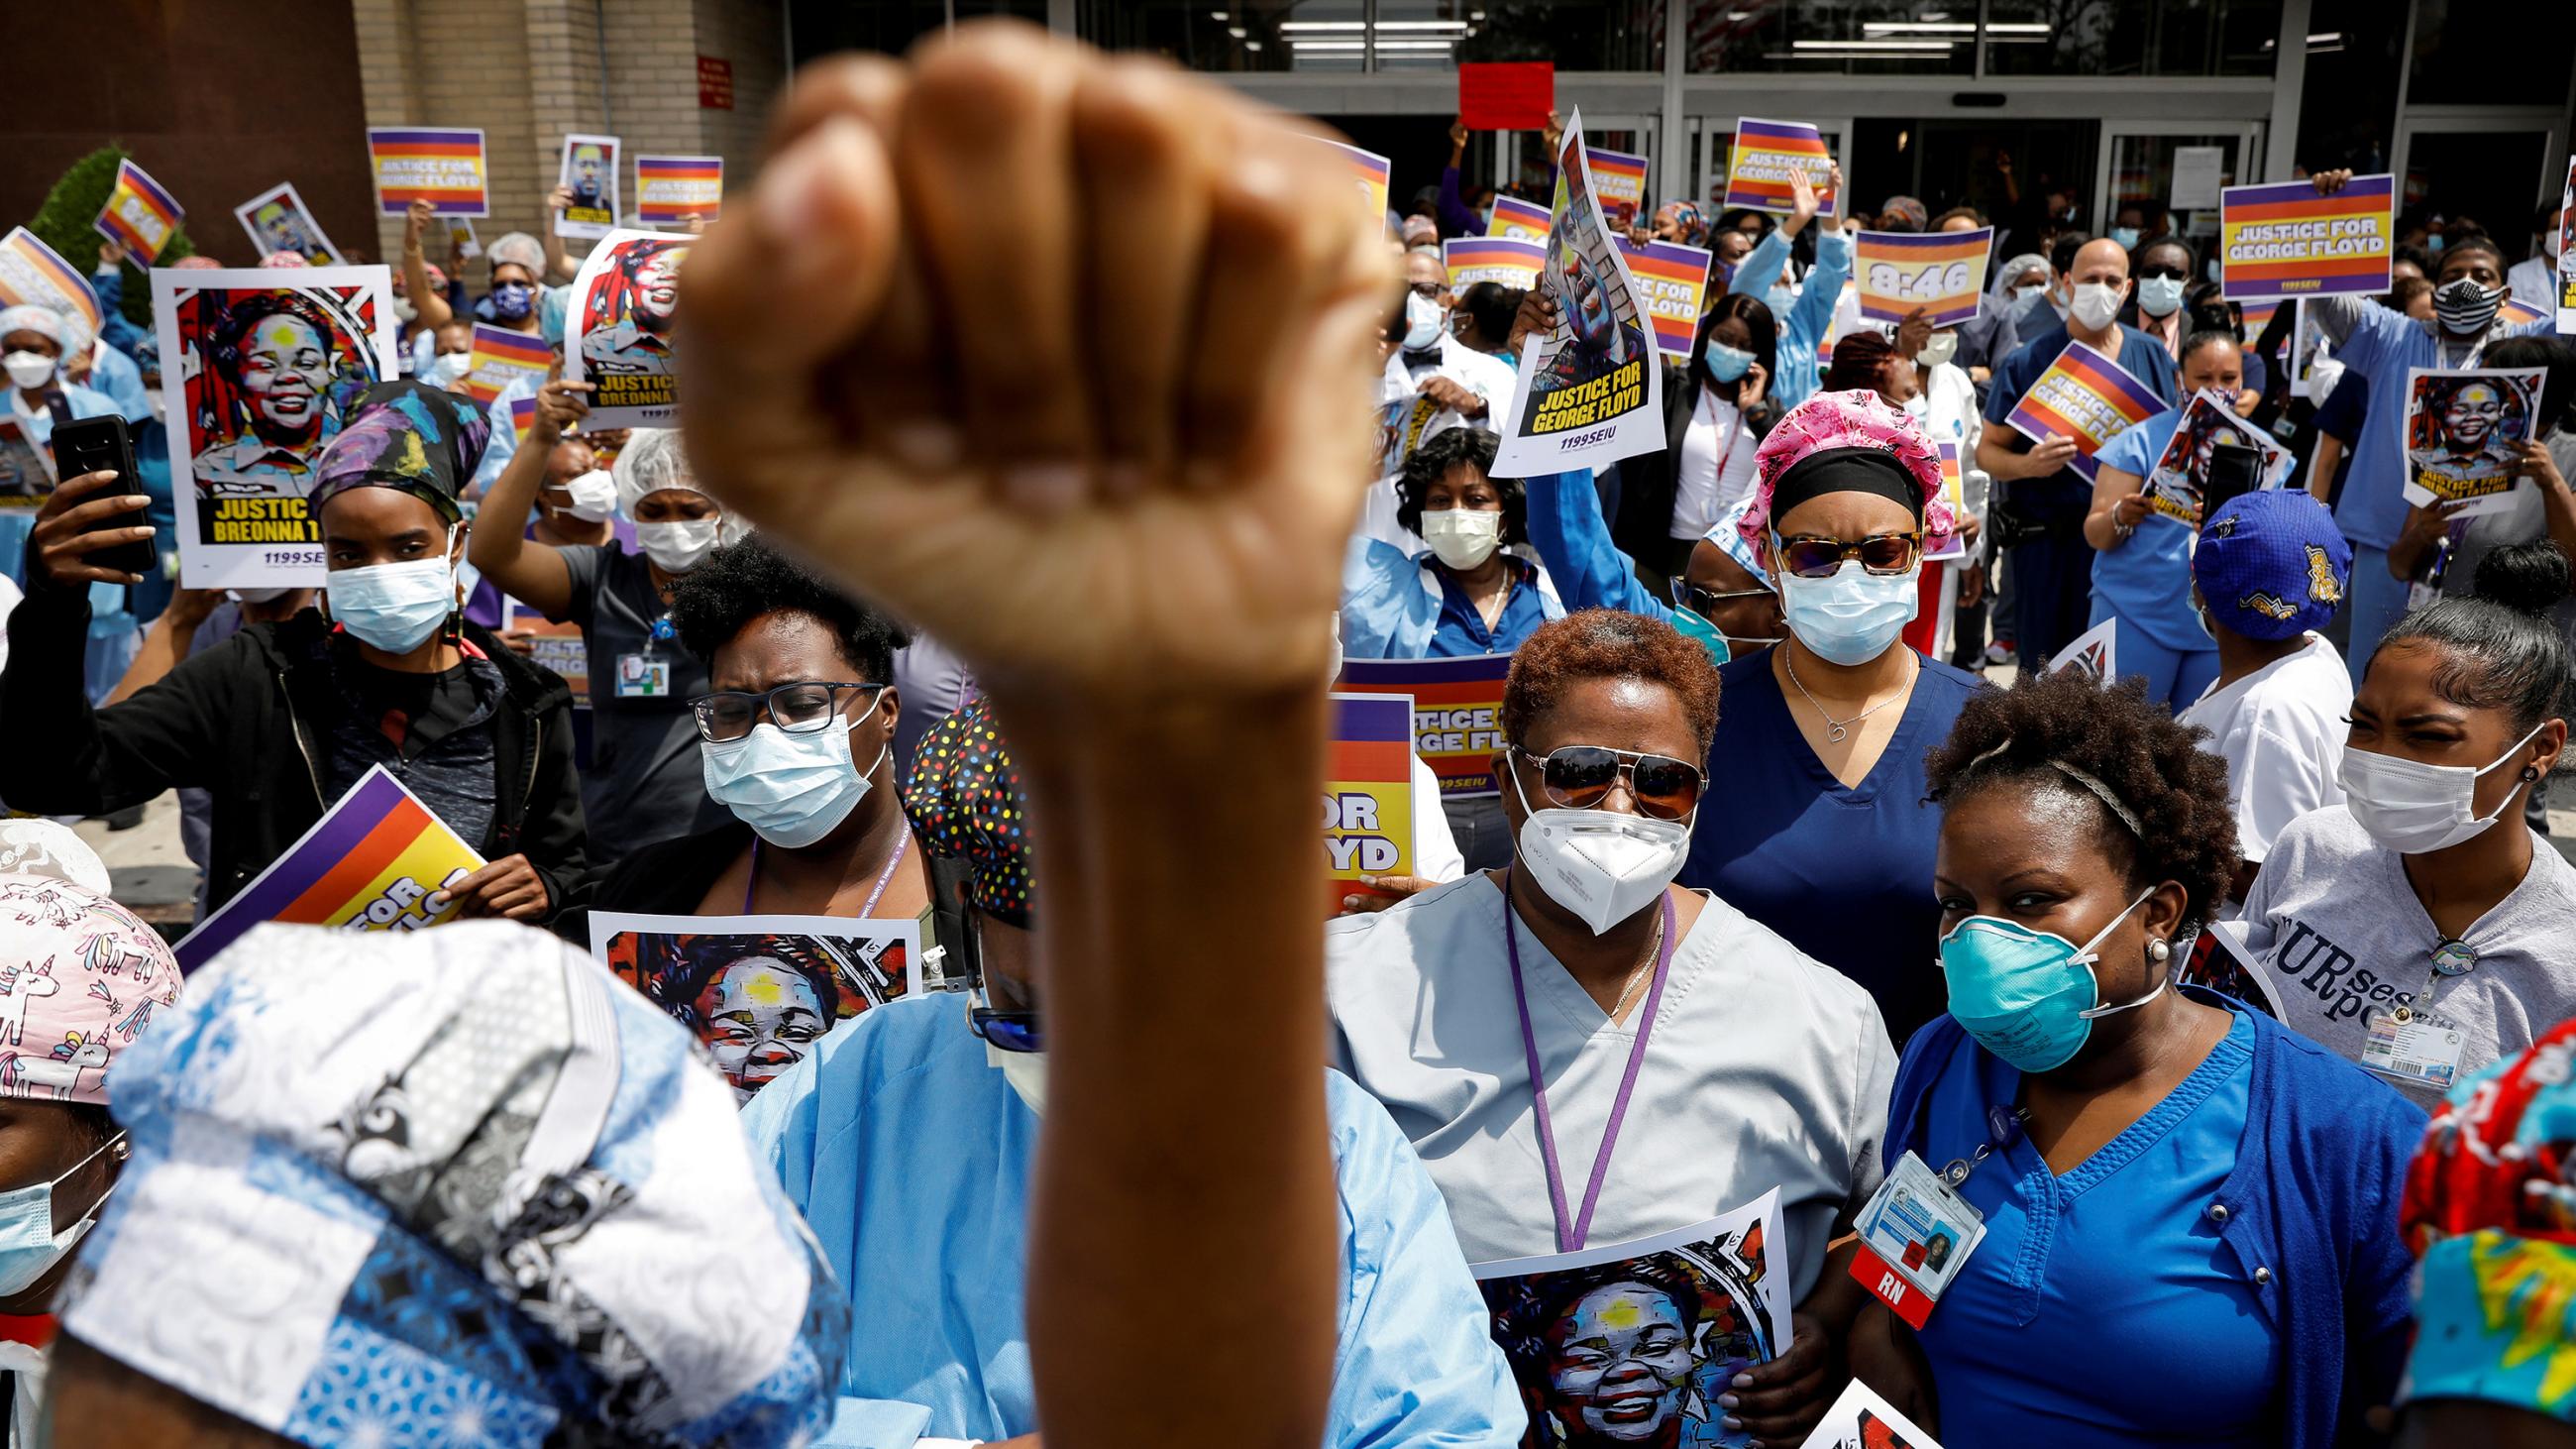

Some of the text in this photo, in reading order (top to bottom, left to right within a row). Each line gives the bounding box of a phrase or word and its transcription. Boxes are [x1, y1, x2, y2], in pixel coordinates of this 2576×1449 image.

[1738, 167, 1790, 180] GEORG
[2235, 217, 2377, 243] JUSTICE FOR
[2229, 236, 2385, 261] GEORGE FLOYD
[1656, 280, 1693, 300] FOR
[1869, 262, 1970, 297] 8:46
[599, 375, 677, 391] JUSTIC
[1539, 360, 1641, 412] JUSTICE FOR
[598, 390, 672, 406] BREONNA
[1532, 385, 1641, 433] GEORGE FLOYD
[2034, 385, 2091, 429] GEORGE
[2049, 375, 2115, 424] JUSTICE
[1560, 425, 1617, 450] 1199SEIU
[214, 498, 308, 520] JUSTIC
[213, 520, 306, 542] BREONNA
[264, 552, 324, 564] 1199SE
[1415, 709, 1493, 730] TICE
[1877, 1271, 1907, 1306] RN
